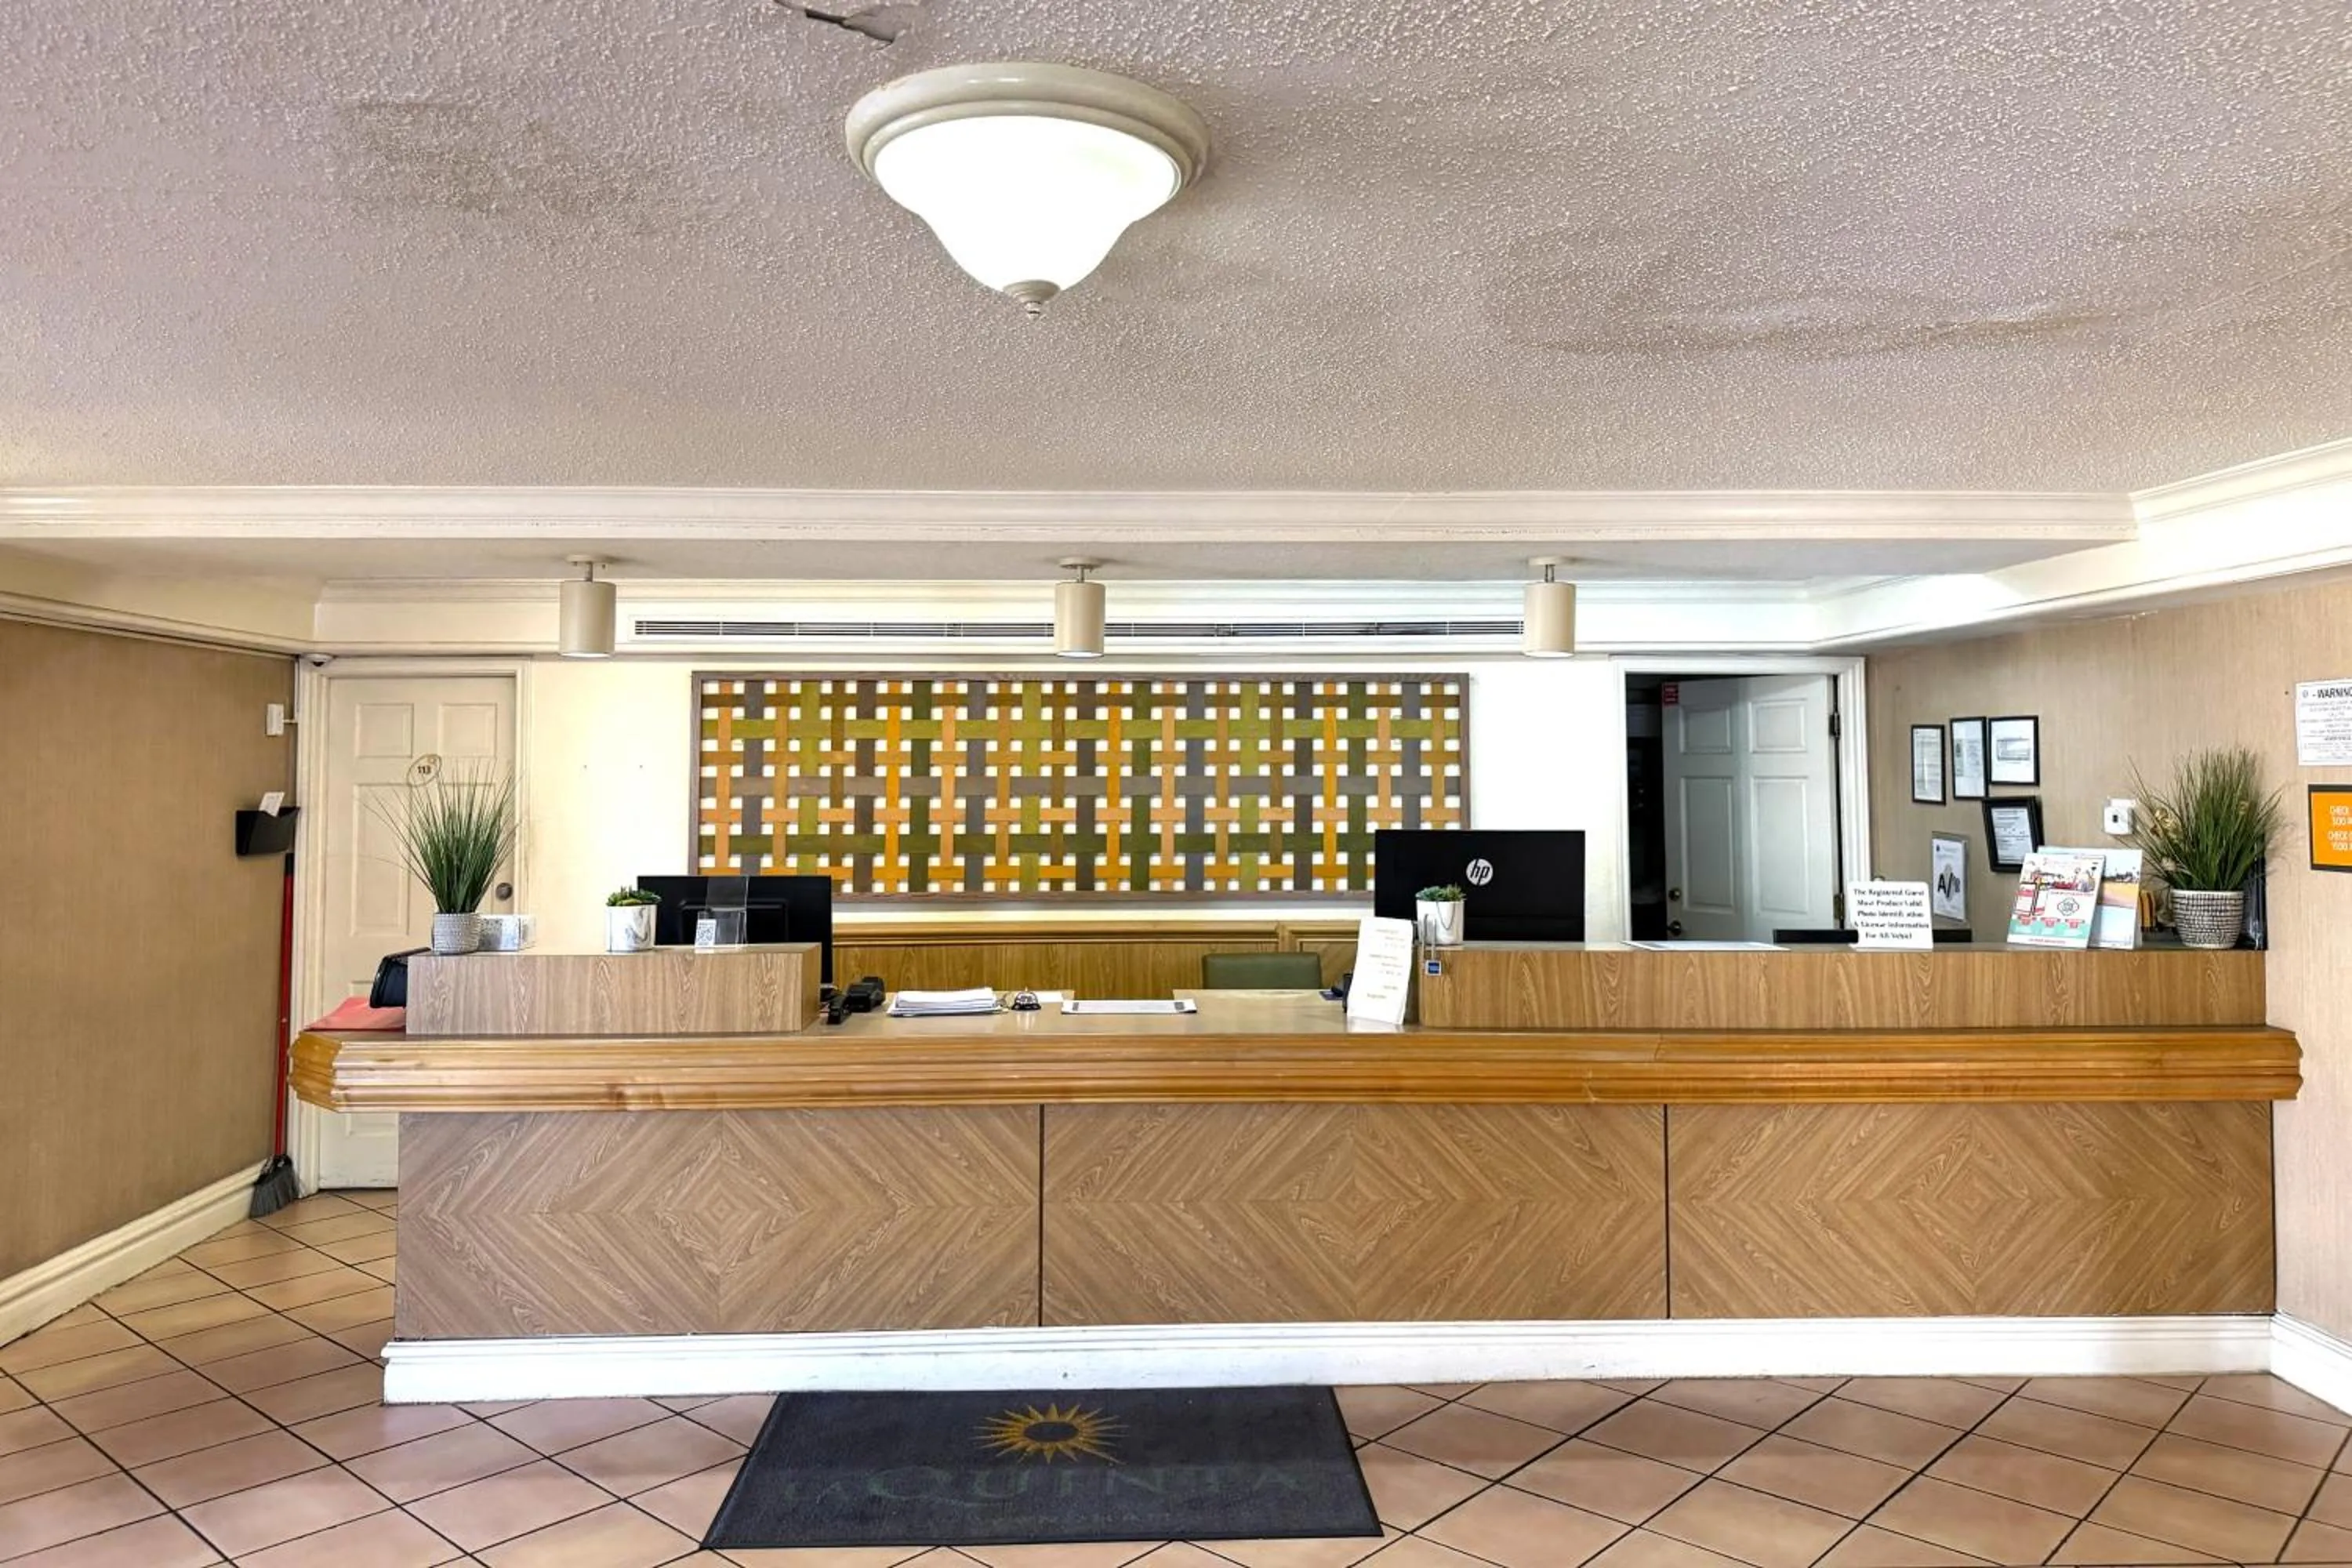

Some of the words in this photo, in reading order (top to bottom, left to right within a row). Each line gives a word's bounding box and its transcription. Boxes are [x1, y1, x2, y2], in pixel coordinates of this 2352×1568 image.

[1470, 858, 1490, 885] hp
[1868, 887, 1904, 898] Registered
[866, 1465, 1302, 1507] QUINTA
